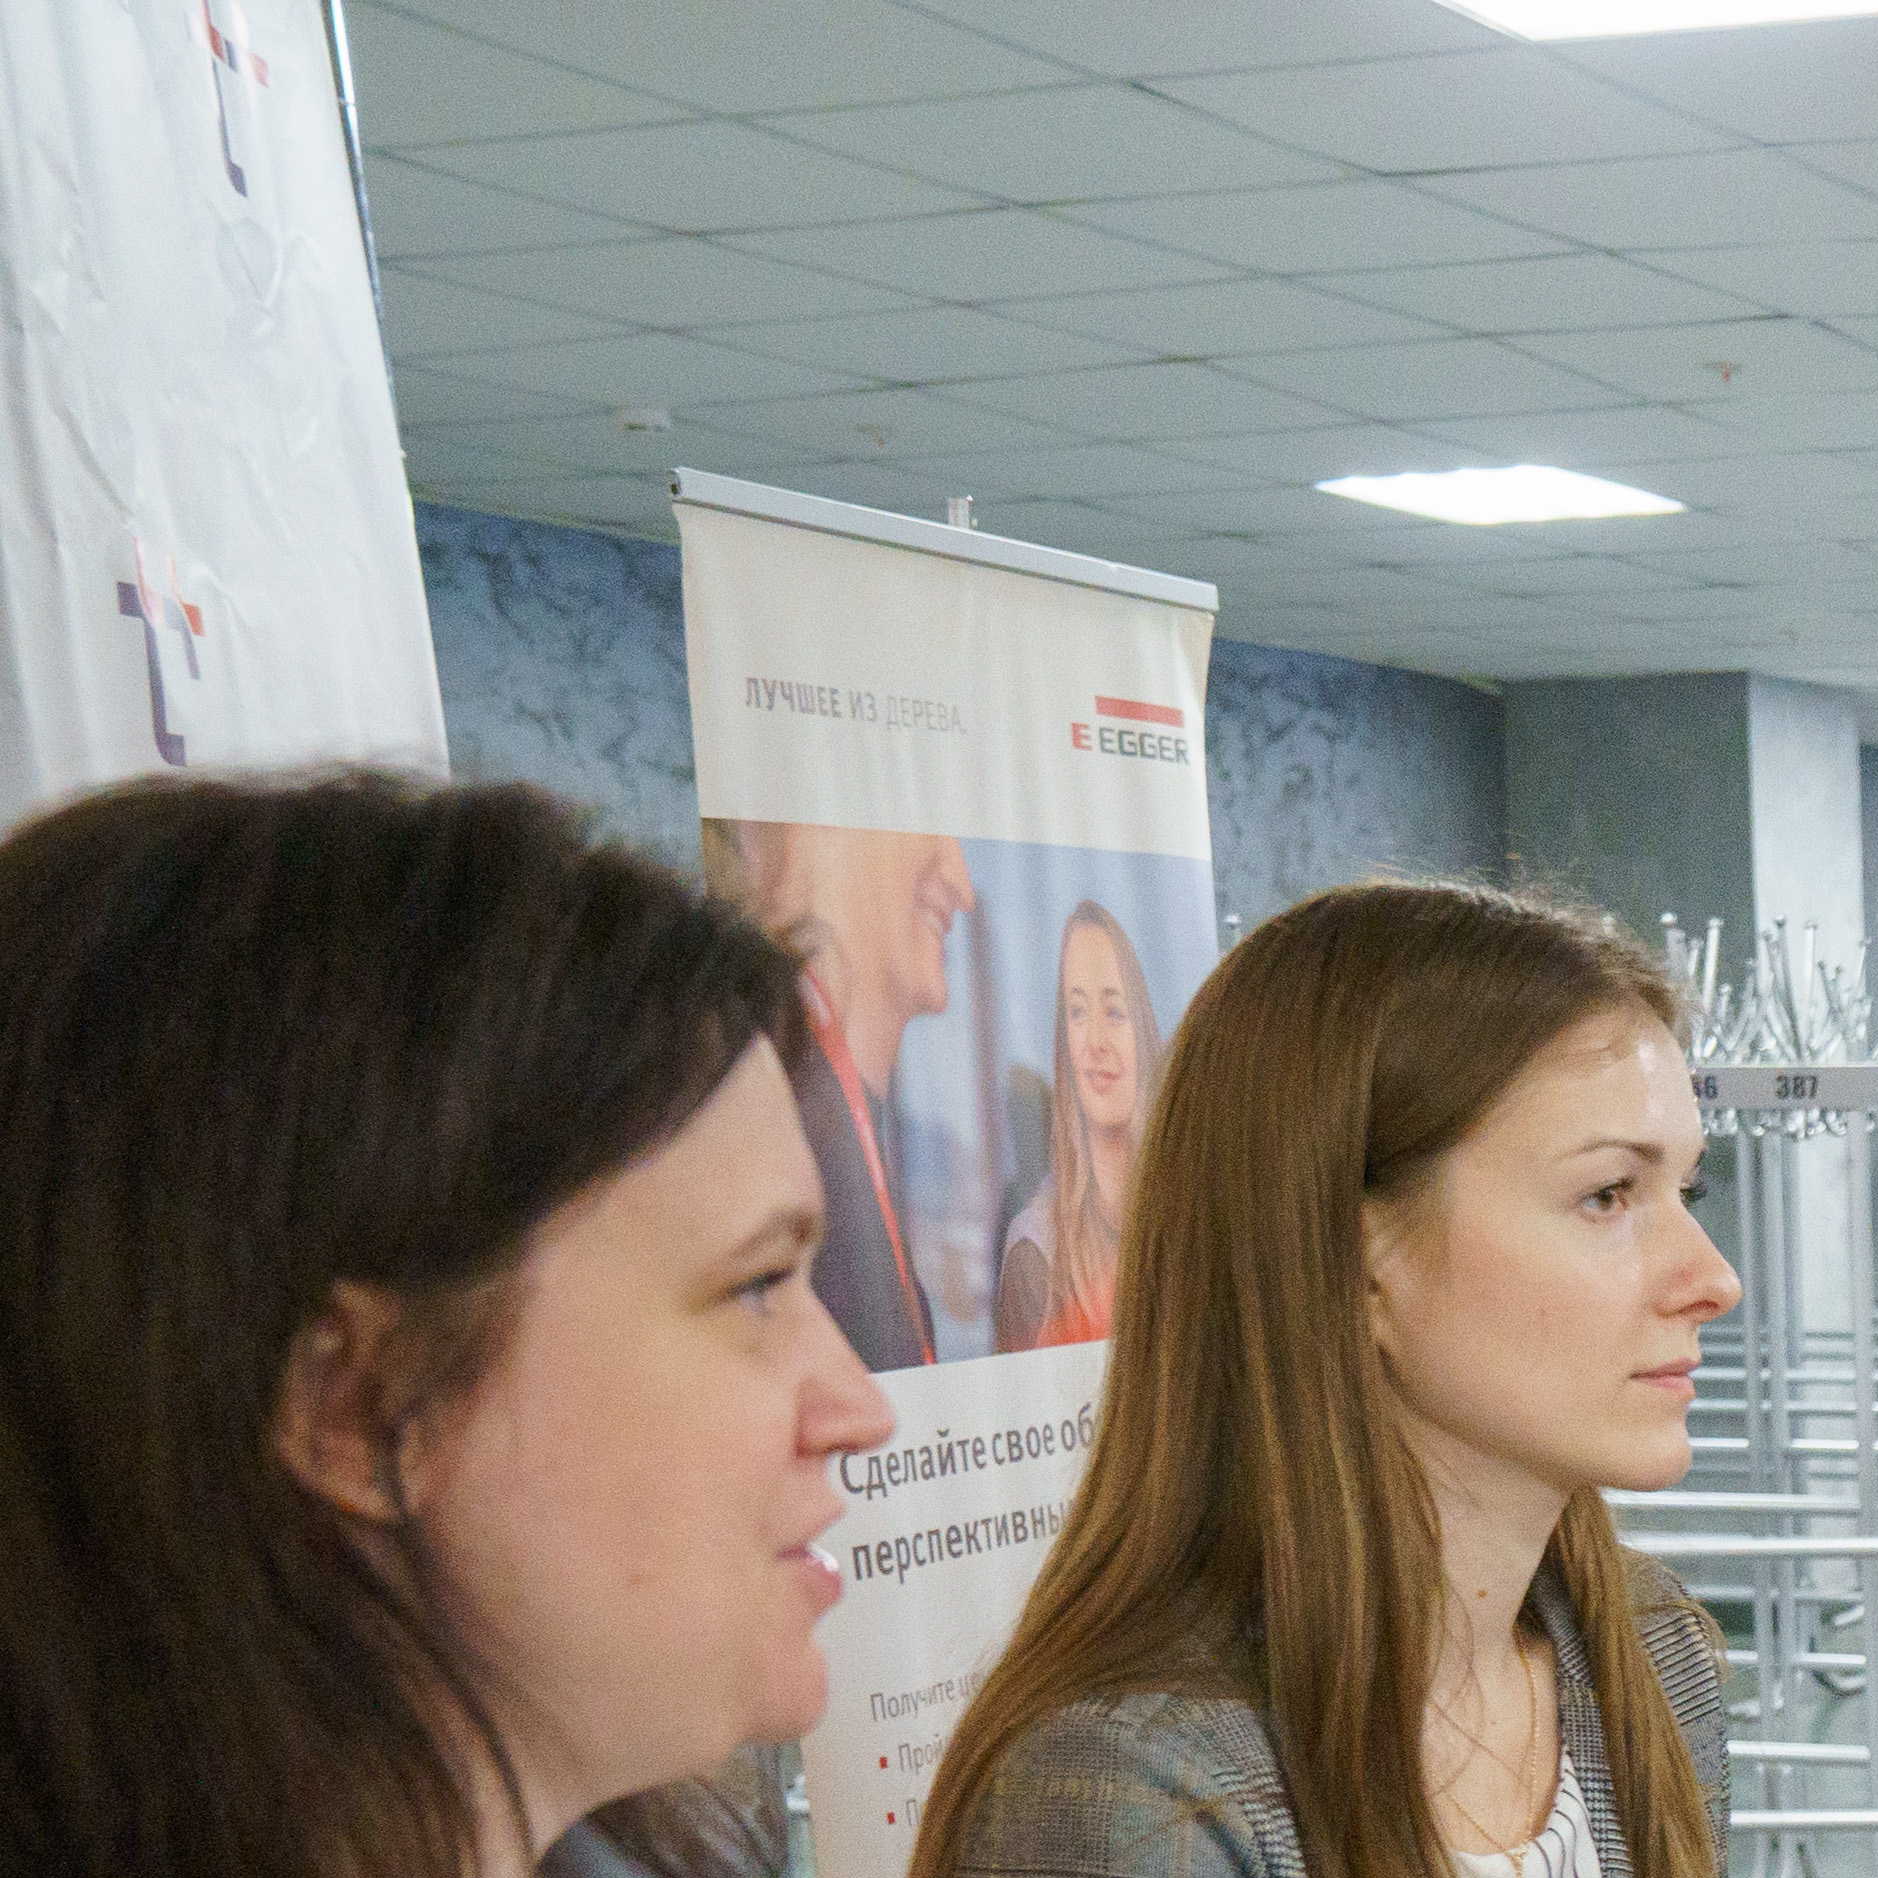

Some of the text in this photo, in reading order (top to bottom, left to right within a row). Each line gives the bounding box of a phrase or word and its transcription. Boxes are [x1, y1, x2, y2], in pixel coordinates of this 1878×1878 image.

[744, 676, 842, 720] ЛУЧШЕЕ
[849, 689, 879, 723] ИЗ
[1098, 724, 1191, 766] EGGER
[1774, 1074, 1819, 1100] 387
[839, 1401, 1096, 1501] Сделайте свое об
[869, 1679, 954, 1722] Получите
